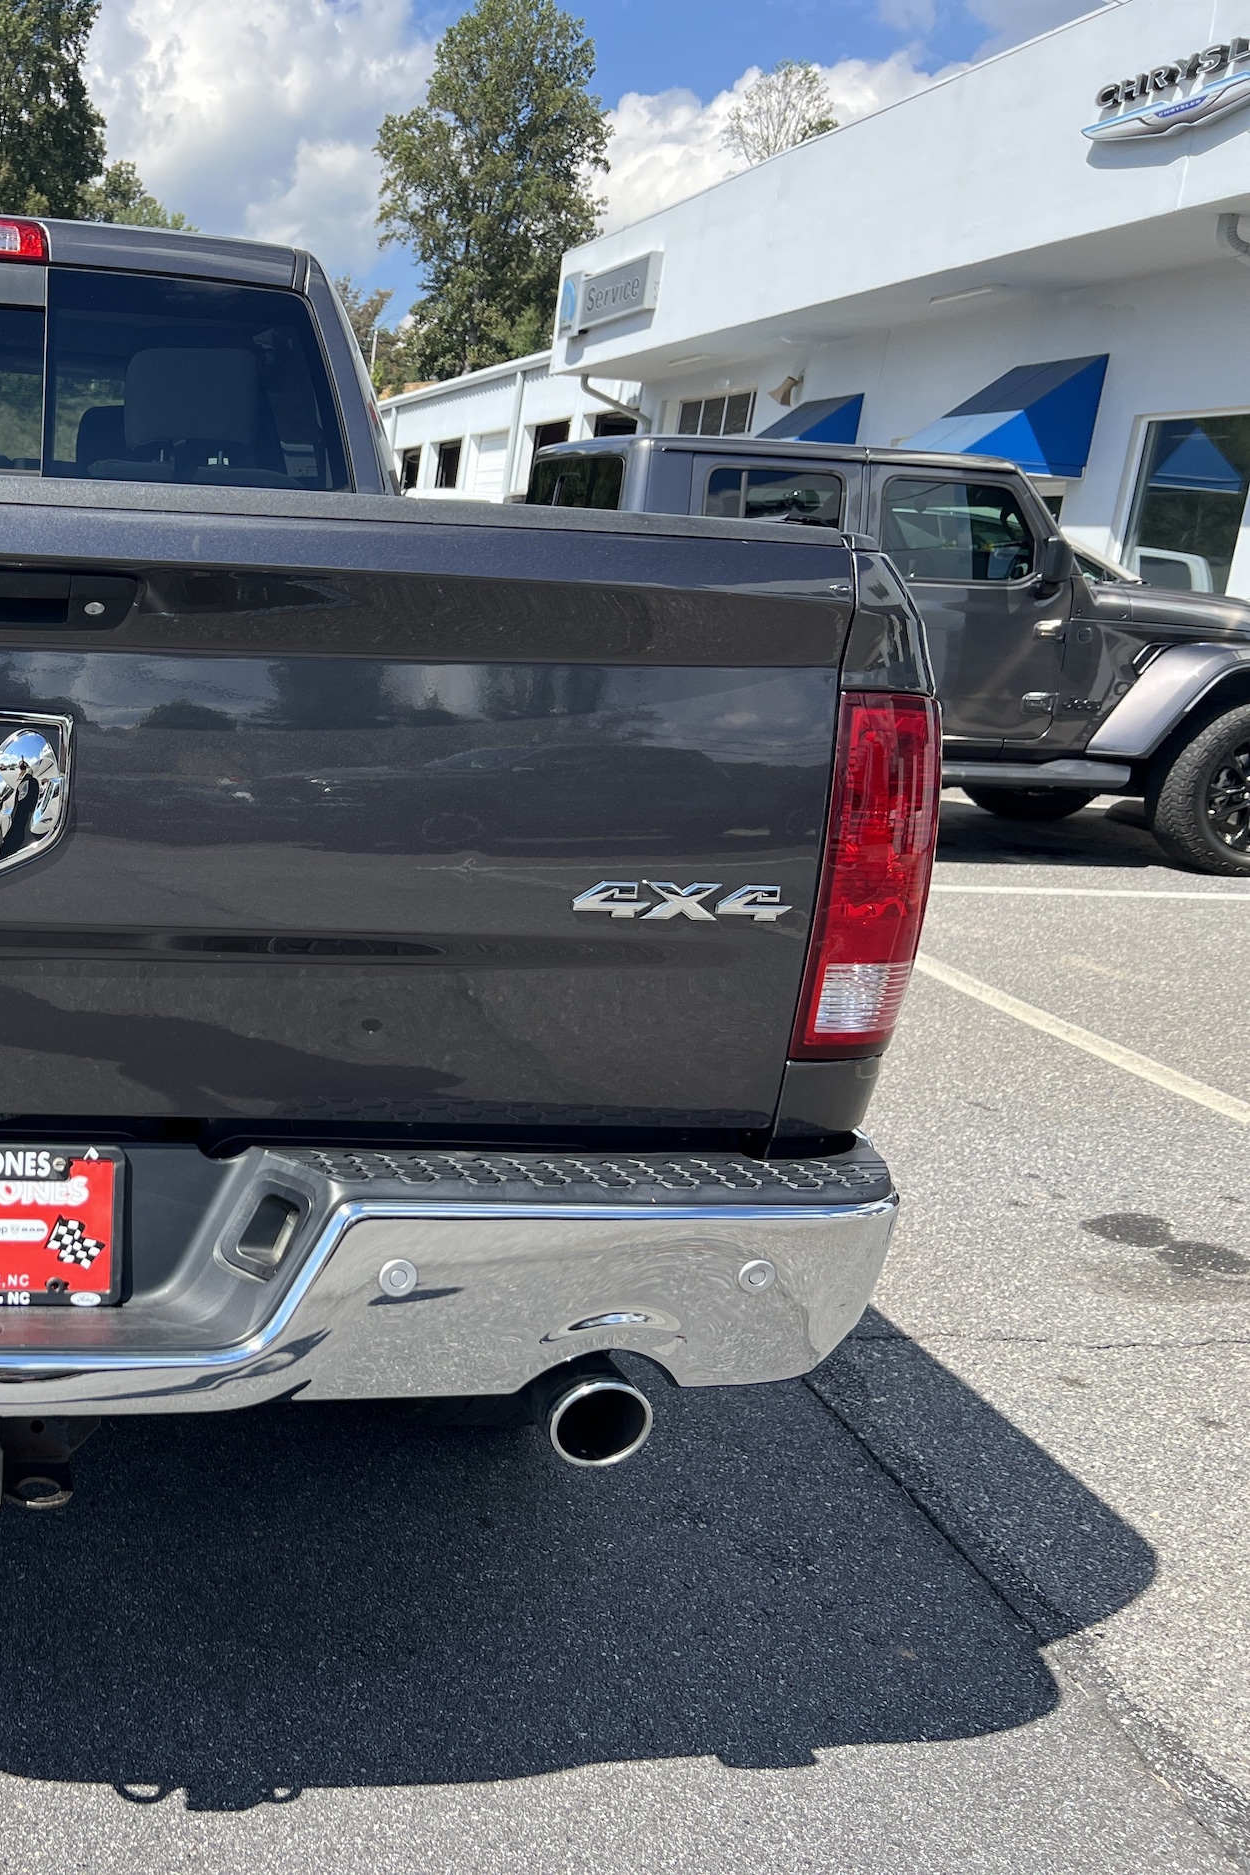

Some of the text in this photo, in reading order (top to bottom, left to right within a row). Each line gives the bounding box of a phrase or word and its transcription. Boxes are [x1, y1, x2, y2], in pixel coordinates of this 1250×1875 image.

[1158, 99, 1202, 118] CHRYSLER
[587, 275, 640, 312] Service
[7, 1291, 30, 1305] NC
